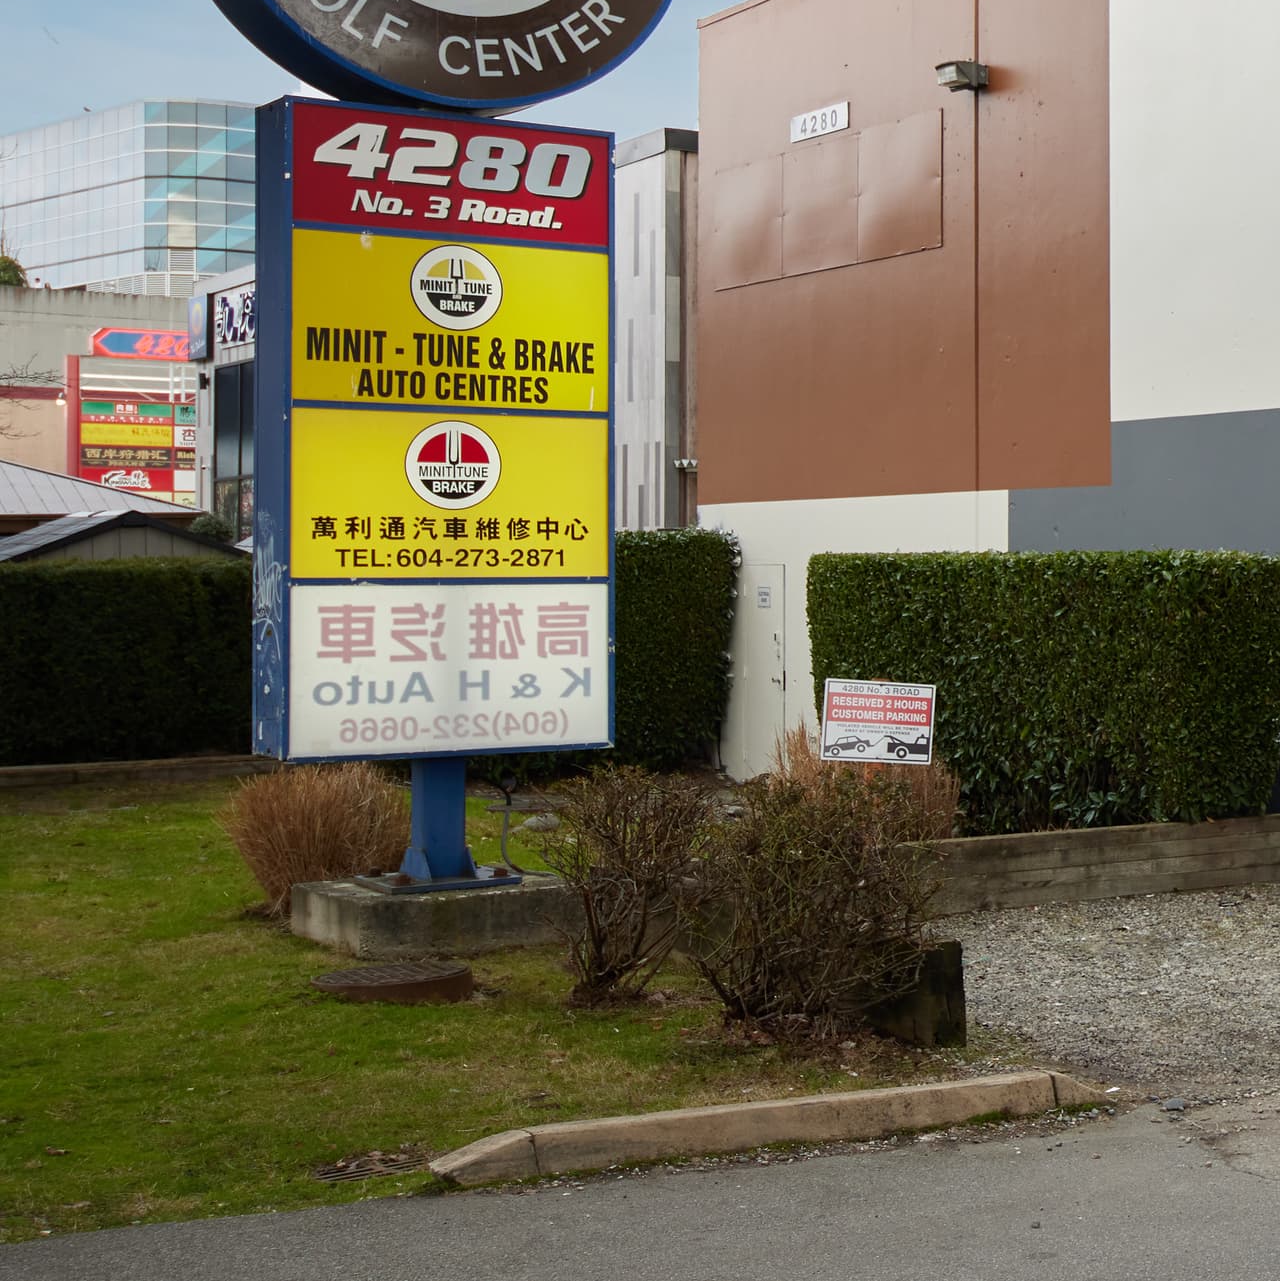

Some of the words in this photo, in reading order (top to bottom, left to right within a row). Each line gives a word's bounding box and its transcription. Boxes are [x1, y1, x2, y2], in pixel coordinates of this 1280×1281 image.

[800, 110, 838, 136] 4280
[313, 122, 592, 199] 4280
[351, 189, 413, 216] No.
[424, 195, 451, 220] 3
[458, 199, 563, 230] Road.
[420, 279, 453, 293] MINIT
[464, 282, 493, 295] TUNE
[440, 300, 475, 313] BRAKE
[306, 327, 387, 364] MINIT
[413, 333, 480, 368] TUNE
[488, 338, 506, 370] &
[514, 339, 595, 374] BRAKE
[357, 369, 426, 398] AUTO
[435, 371, 549, 404] CENTRES
[419, 465, 452, 477] MINIT
[457, 466, 488, 478] TUNE
[432, 481, 475, 493] BRAKE
[311, 516, 589, 541] 萬利通汽車維修中心
[842, 685, 864, 693] 4280
[893, 688, 920, 696] ROAD
[832, 696, 884, 708] RESERVED
[886, 700, 892, 709] 2
[894, 700, 928, 711] HOURS
[832, 709, 884, 720] CUSTOMER
[886, 712, 927, 723] PARKING
